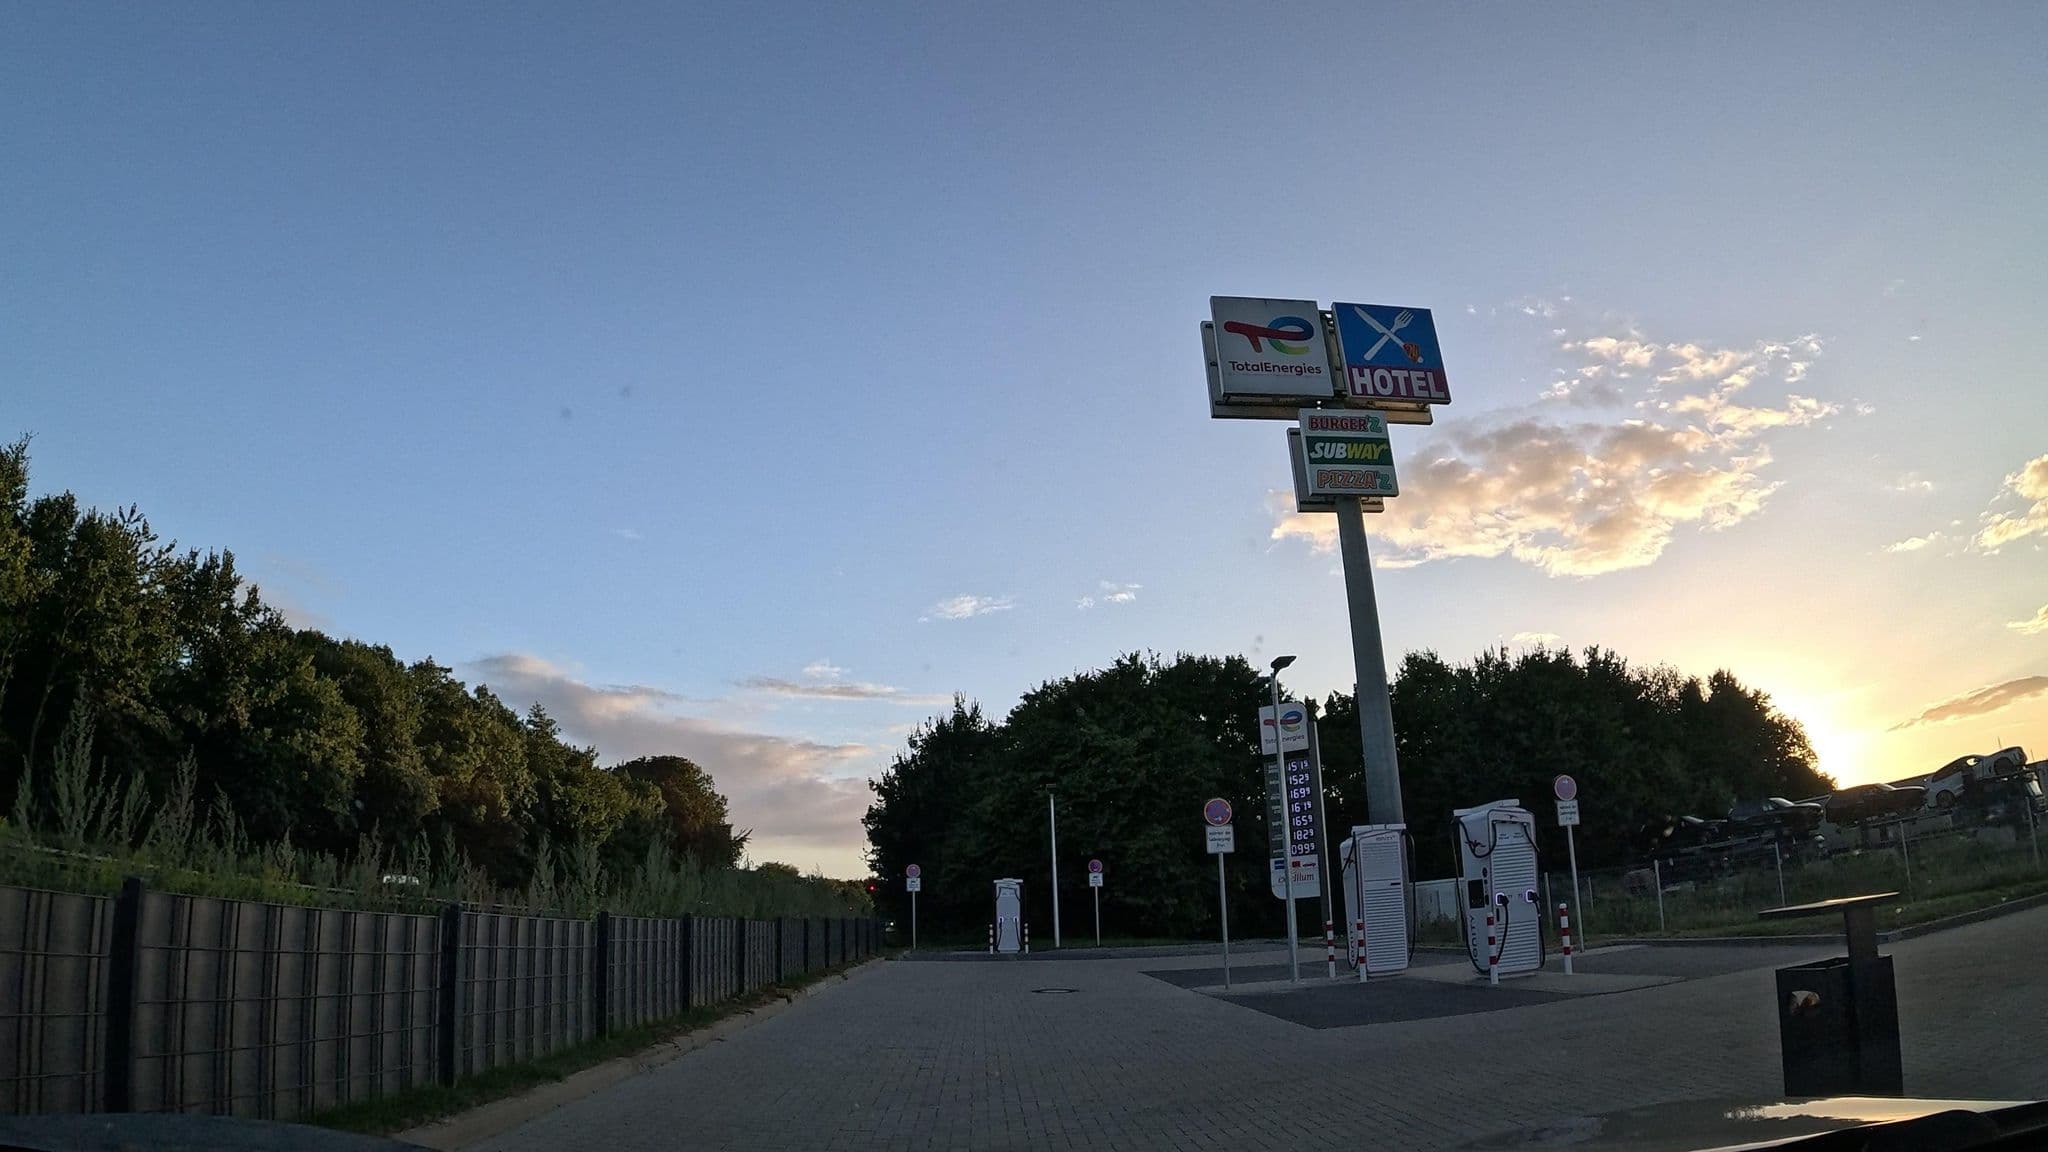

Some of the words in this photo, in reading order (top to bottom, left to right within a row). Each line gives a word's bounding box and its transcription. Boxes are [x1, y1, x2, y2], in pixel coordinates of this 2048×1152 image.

[1229, 361, 1322, 376] TotalEnergies
[1351, 367, 1446, 399] HOTEL
[1310, 441, 1388, 460] SUBWAY
[1290, 787, 1311, 799] 1699
[1291, 801, 1312, 813] 1619
[1292, 814, 1313, 827] 1659
[1293, 828, 1315, 841] 1829
[1291, 842, 1315, 855] 0999
